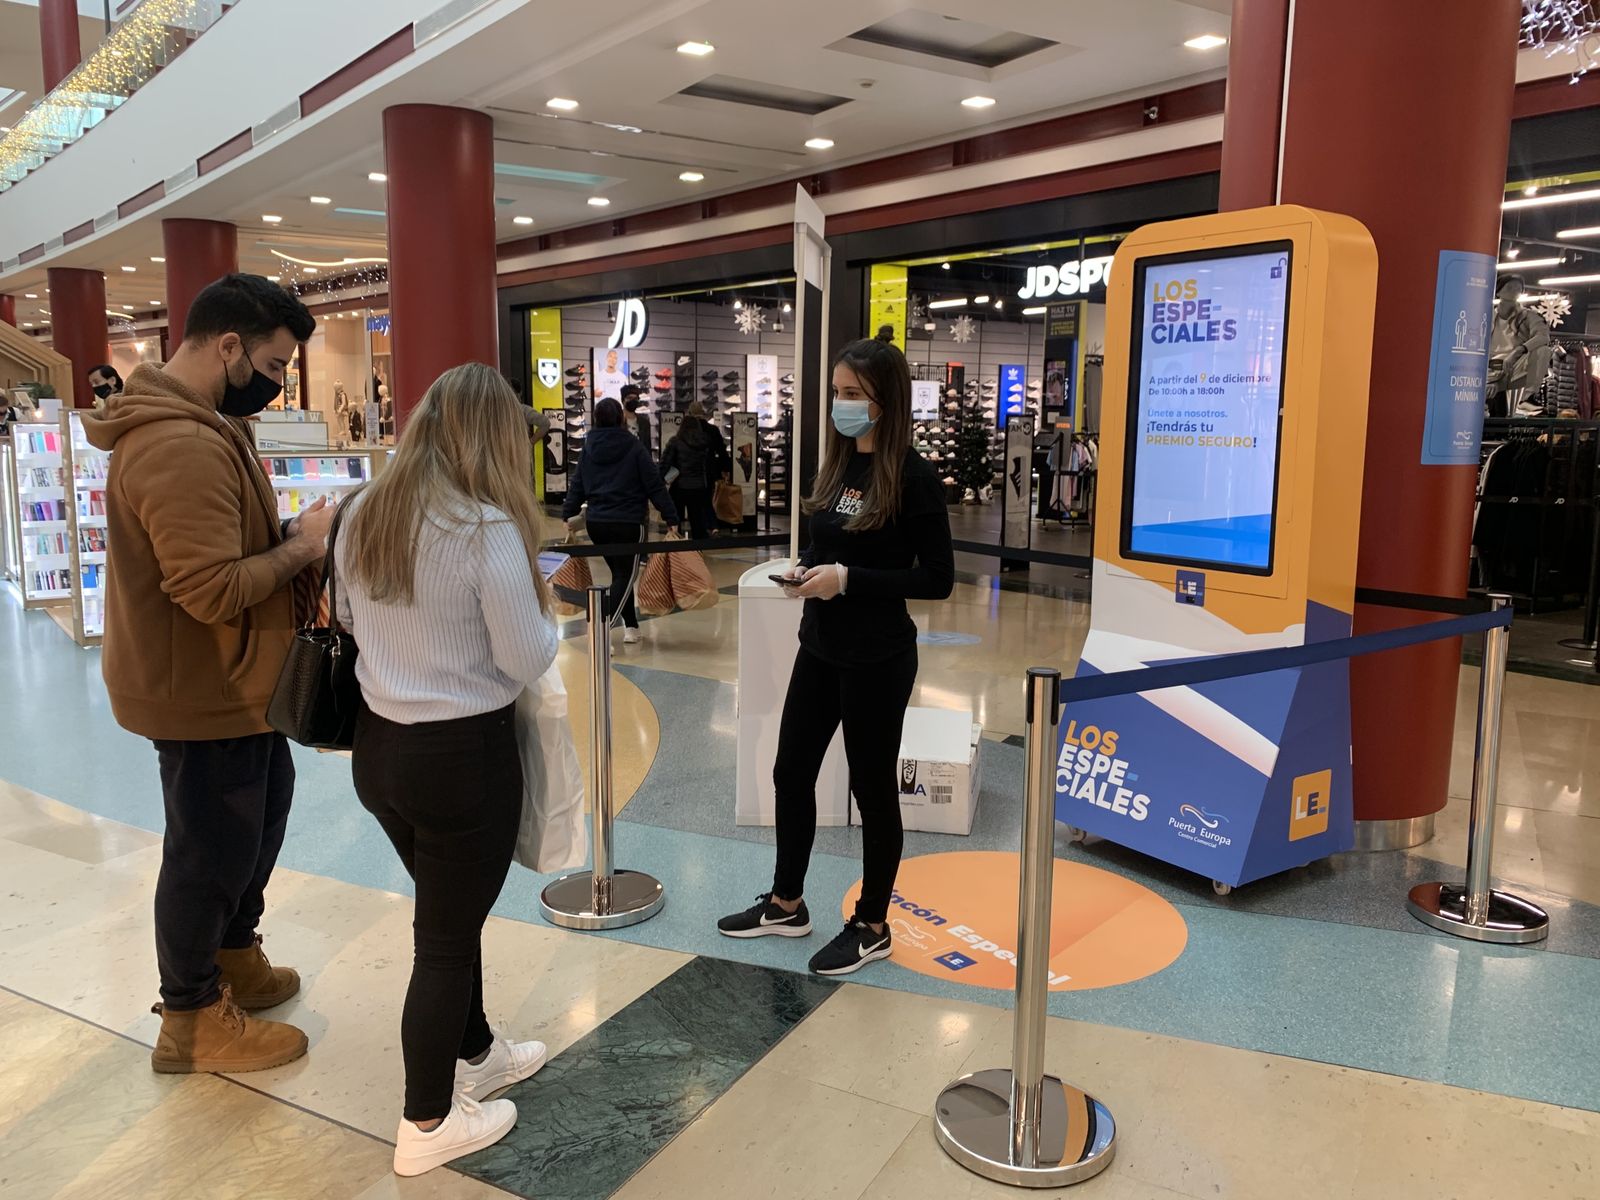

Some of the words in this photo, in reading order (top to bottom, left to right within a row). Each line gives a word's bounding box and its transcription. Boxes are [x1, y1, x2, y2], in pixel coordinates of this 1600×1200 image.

[1153, 279, 1198, 303] LOS
[608, 298, 647, 349] JD
[1152, 299, 1222, 324] ESPE-
[1151, 319, 1237, 344] CIALES
[1149, 375, 1156, 384] A
[1157, 375, 1182, 386] partir
[1183, 375, 1198, 384] del
[1200, 373, 1207, 384] 9
[1209, 374, 1221, 383] de
[1149, 388, 1160, 396] De
[1162, 387, 1188, 396] 10:00h
[1197, 386, 1225, 396] 18:00h
[1184, 409, 1229, 418] nosotros.
[1146, 421, 1198, 433] ¡Tendrás
[1200, 422, 1214, 432] tu
[1146, 434, 1195, 447] PREMIO
[1198, 435, 1257, 448] SEGURO!
[843, 487, 862, 499] LOS
[1065, 720, 1119, 756] LOS
[1057, 743, 1139, 786] ESPE-
[1055, 768, 1151, 821] CIALES
[1168, 817, 1196, 834] Puerta
[1200, 827, 1232, 846] Europa
[1178, 831, 1193, 841] Centro
